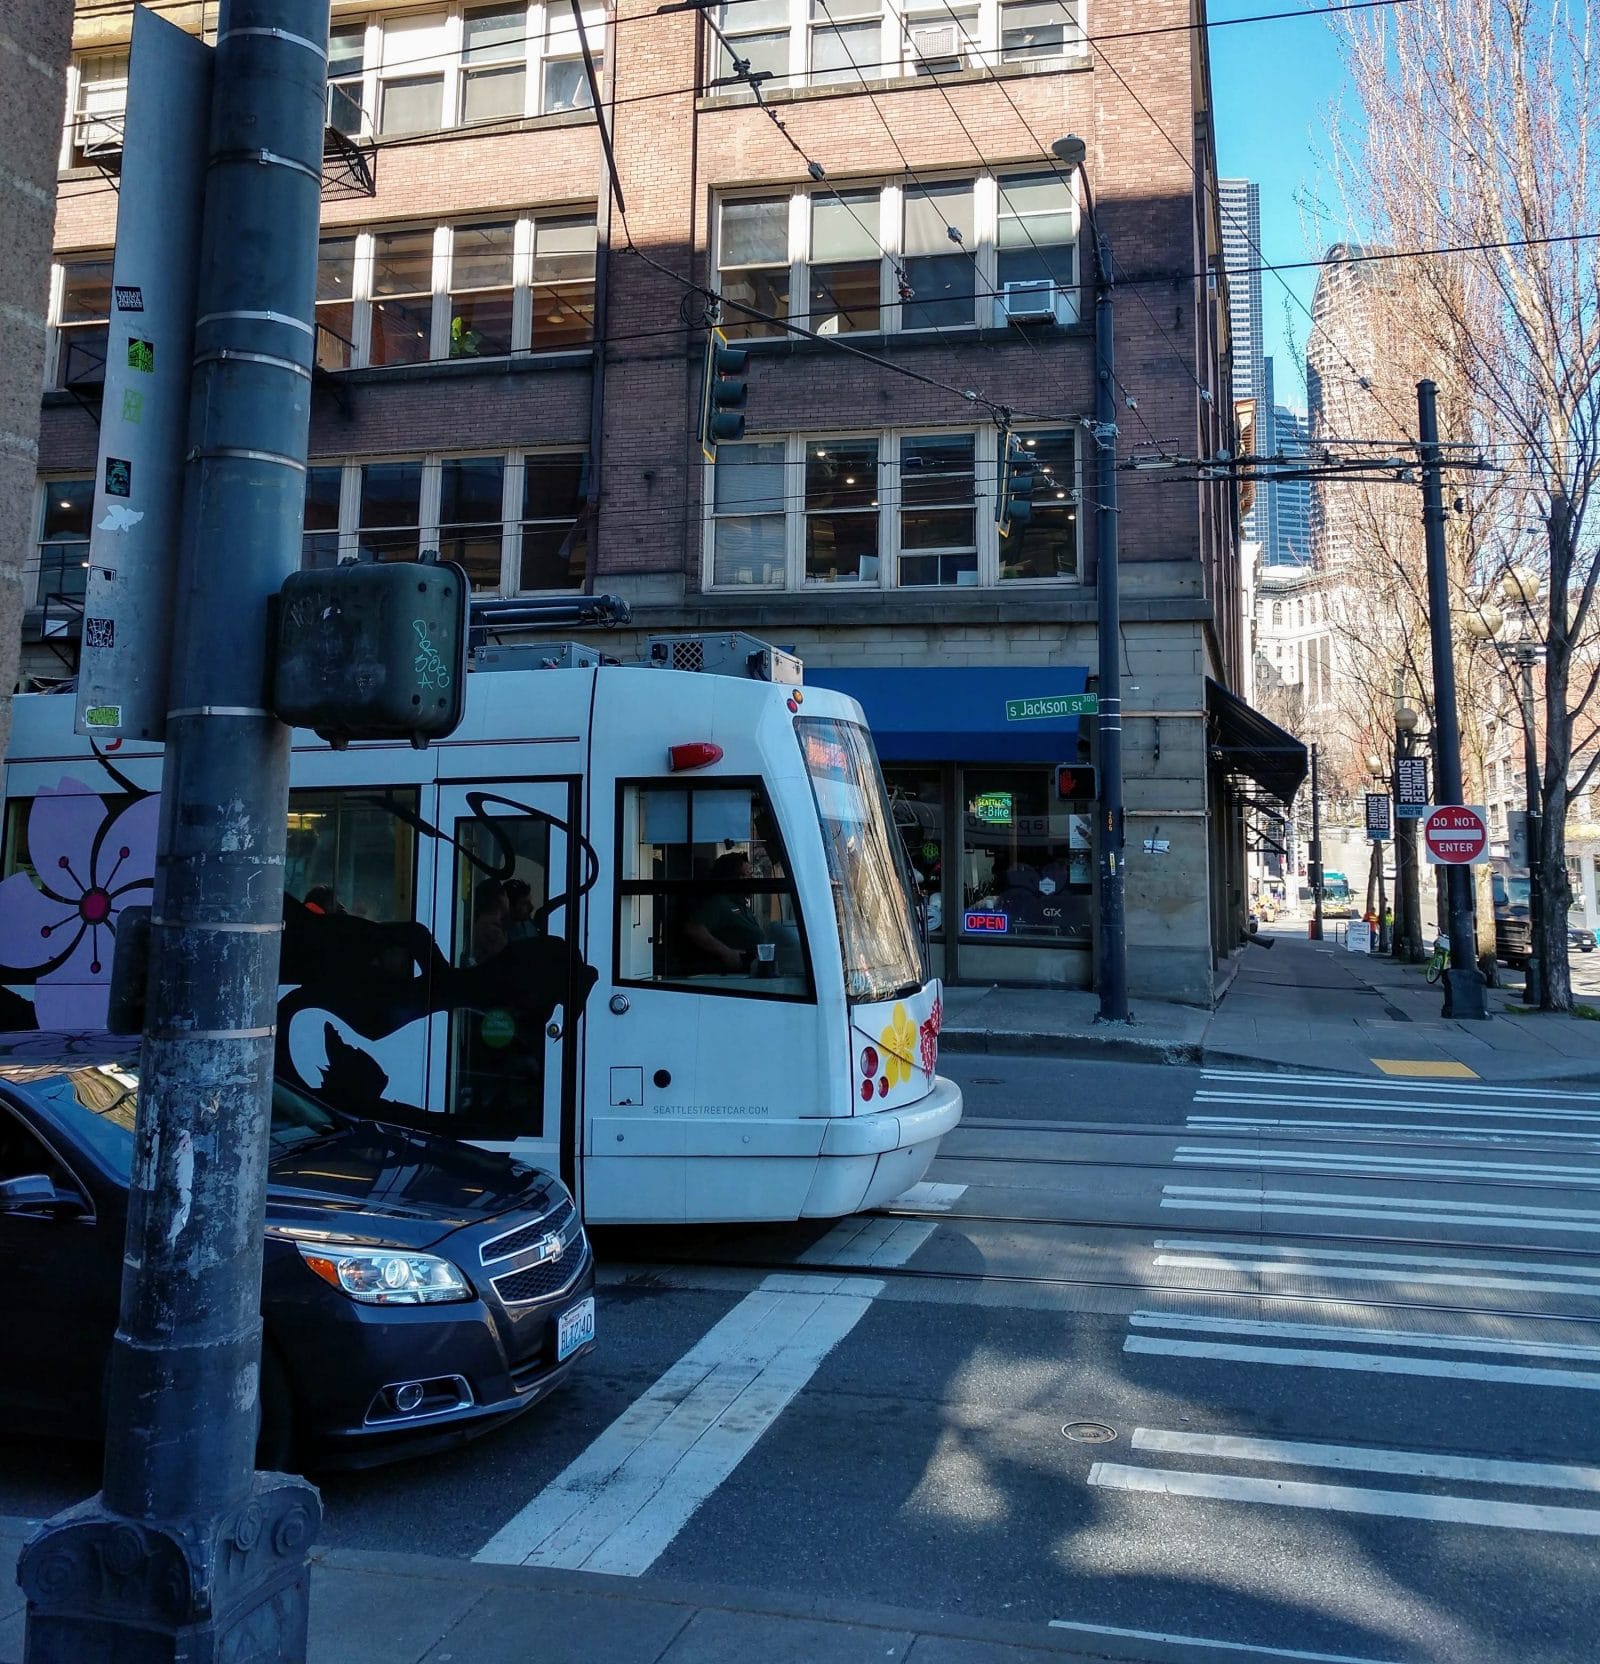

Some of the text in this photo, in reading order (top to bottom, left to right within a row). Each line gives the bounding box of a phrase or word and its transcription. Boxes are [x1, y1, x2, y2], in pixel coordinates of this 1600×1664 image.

[1010, 694, 1096, 717] S Jackson St 300
[1398, 759, 1413, 803] SQUARE
[1411, 759, 1426, 803] PIONEER
[977, 805, 1010, 818] E-Bike
[1368, 796, 1379, 829] SQUARE
[1378, 796, 1389, 829] PIONEER
[1433, 817, 1476, 827] DO NOT
[1439, 842, 1473, 852] ENTER
[967, 916, 1005, 929] OPEN
[653, 1105, 769, 1115] SEATTLESTREETCAR.COM
